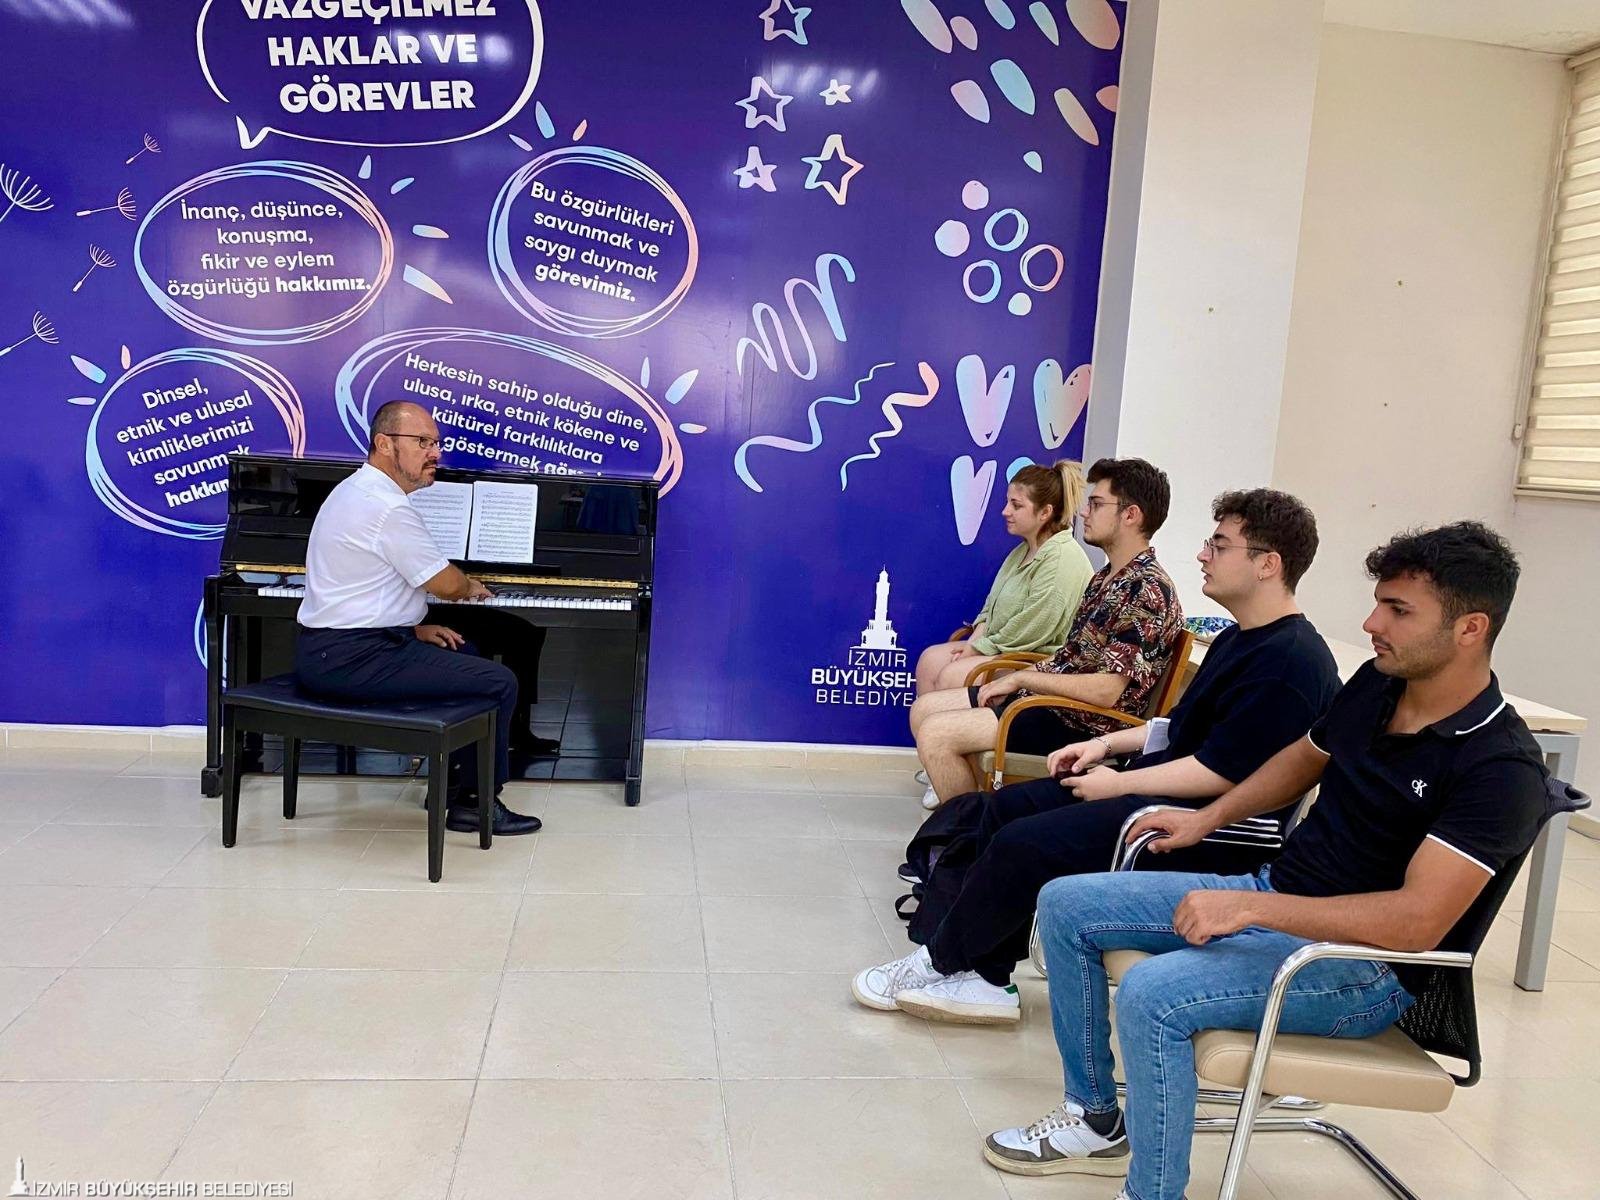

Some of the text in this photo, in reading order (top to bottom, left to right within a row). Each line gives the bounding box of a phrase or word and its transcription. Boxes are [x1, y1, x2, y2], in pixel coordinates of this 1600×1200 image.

[268, 34, 478, 66] HAKLAR VE
[279, 75, 476, 114] GÖREVLER
[181, 199, 343, 222] İnanç, düşünce,
[531, 181, 674, 236] Bu özgürlükleri
[217, 228, 313, 246] konuşma,
[534, 211, 660, 257] savunmak ve
[201, 251, 334, 272] fikir ve eylem
[524, 234, 658, 283] saygı duymak
[167, 276, 371, 300] özgürlüğü hakkımız.
[535, 263, 636, 303] görevimiz.
[142, 377, 209, 409] Dinsel,
[405, 352, 648, 433] Herkesin sahip olduğu dine,
[116, 390, 253, 443] etnik ve ulusal
[403, 377, 640, 451] ulusa, ırka, etnik kökene ve
[127, 416, 255, 467] kimliklerimizi
[431, 406, 603, 465] kültürel farklılıklara
[443, 436, 541, 471] göstermek
[154, 445, 250, 485] savunmk
[811, 666, 917, 690] BÜYÜKŞEH
[848, 650, 907, 668] İZMİR
[816, 689, 913, 707] BELEDİYE
